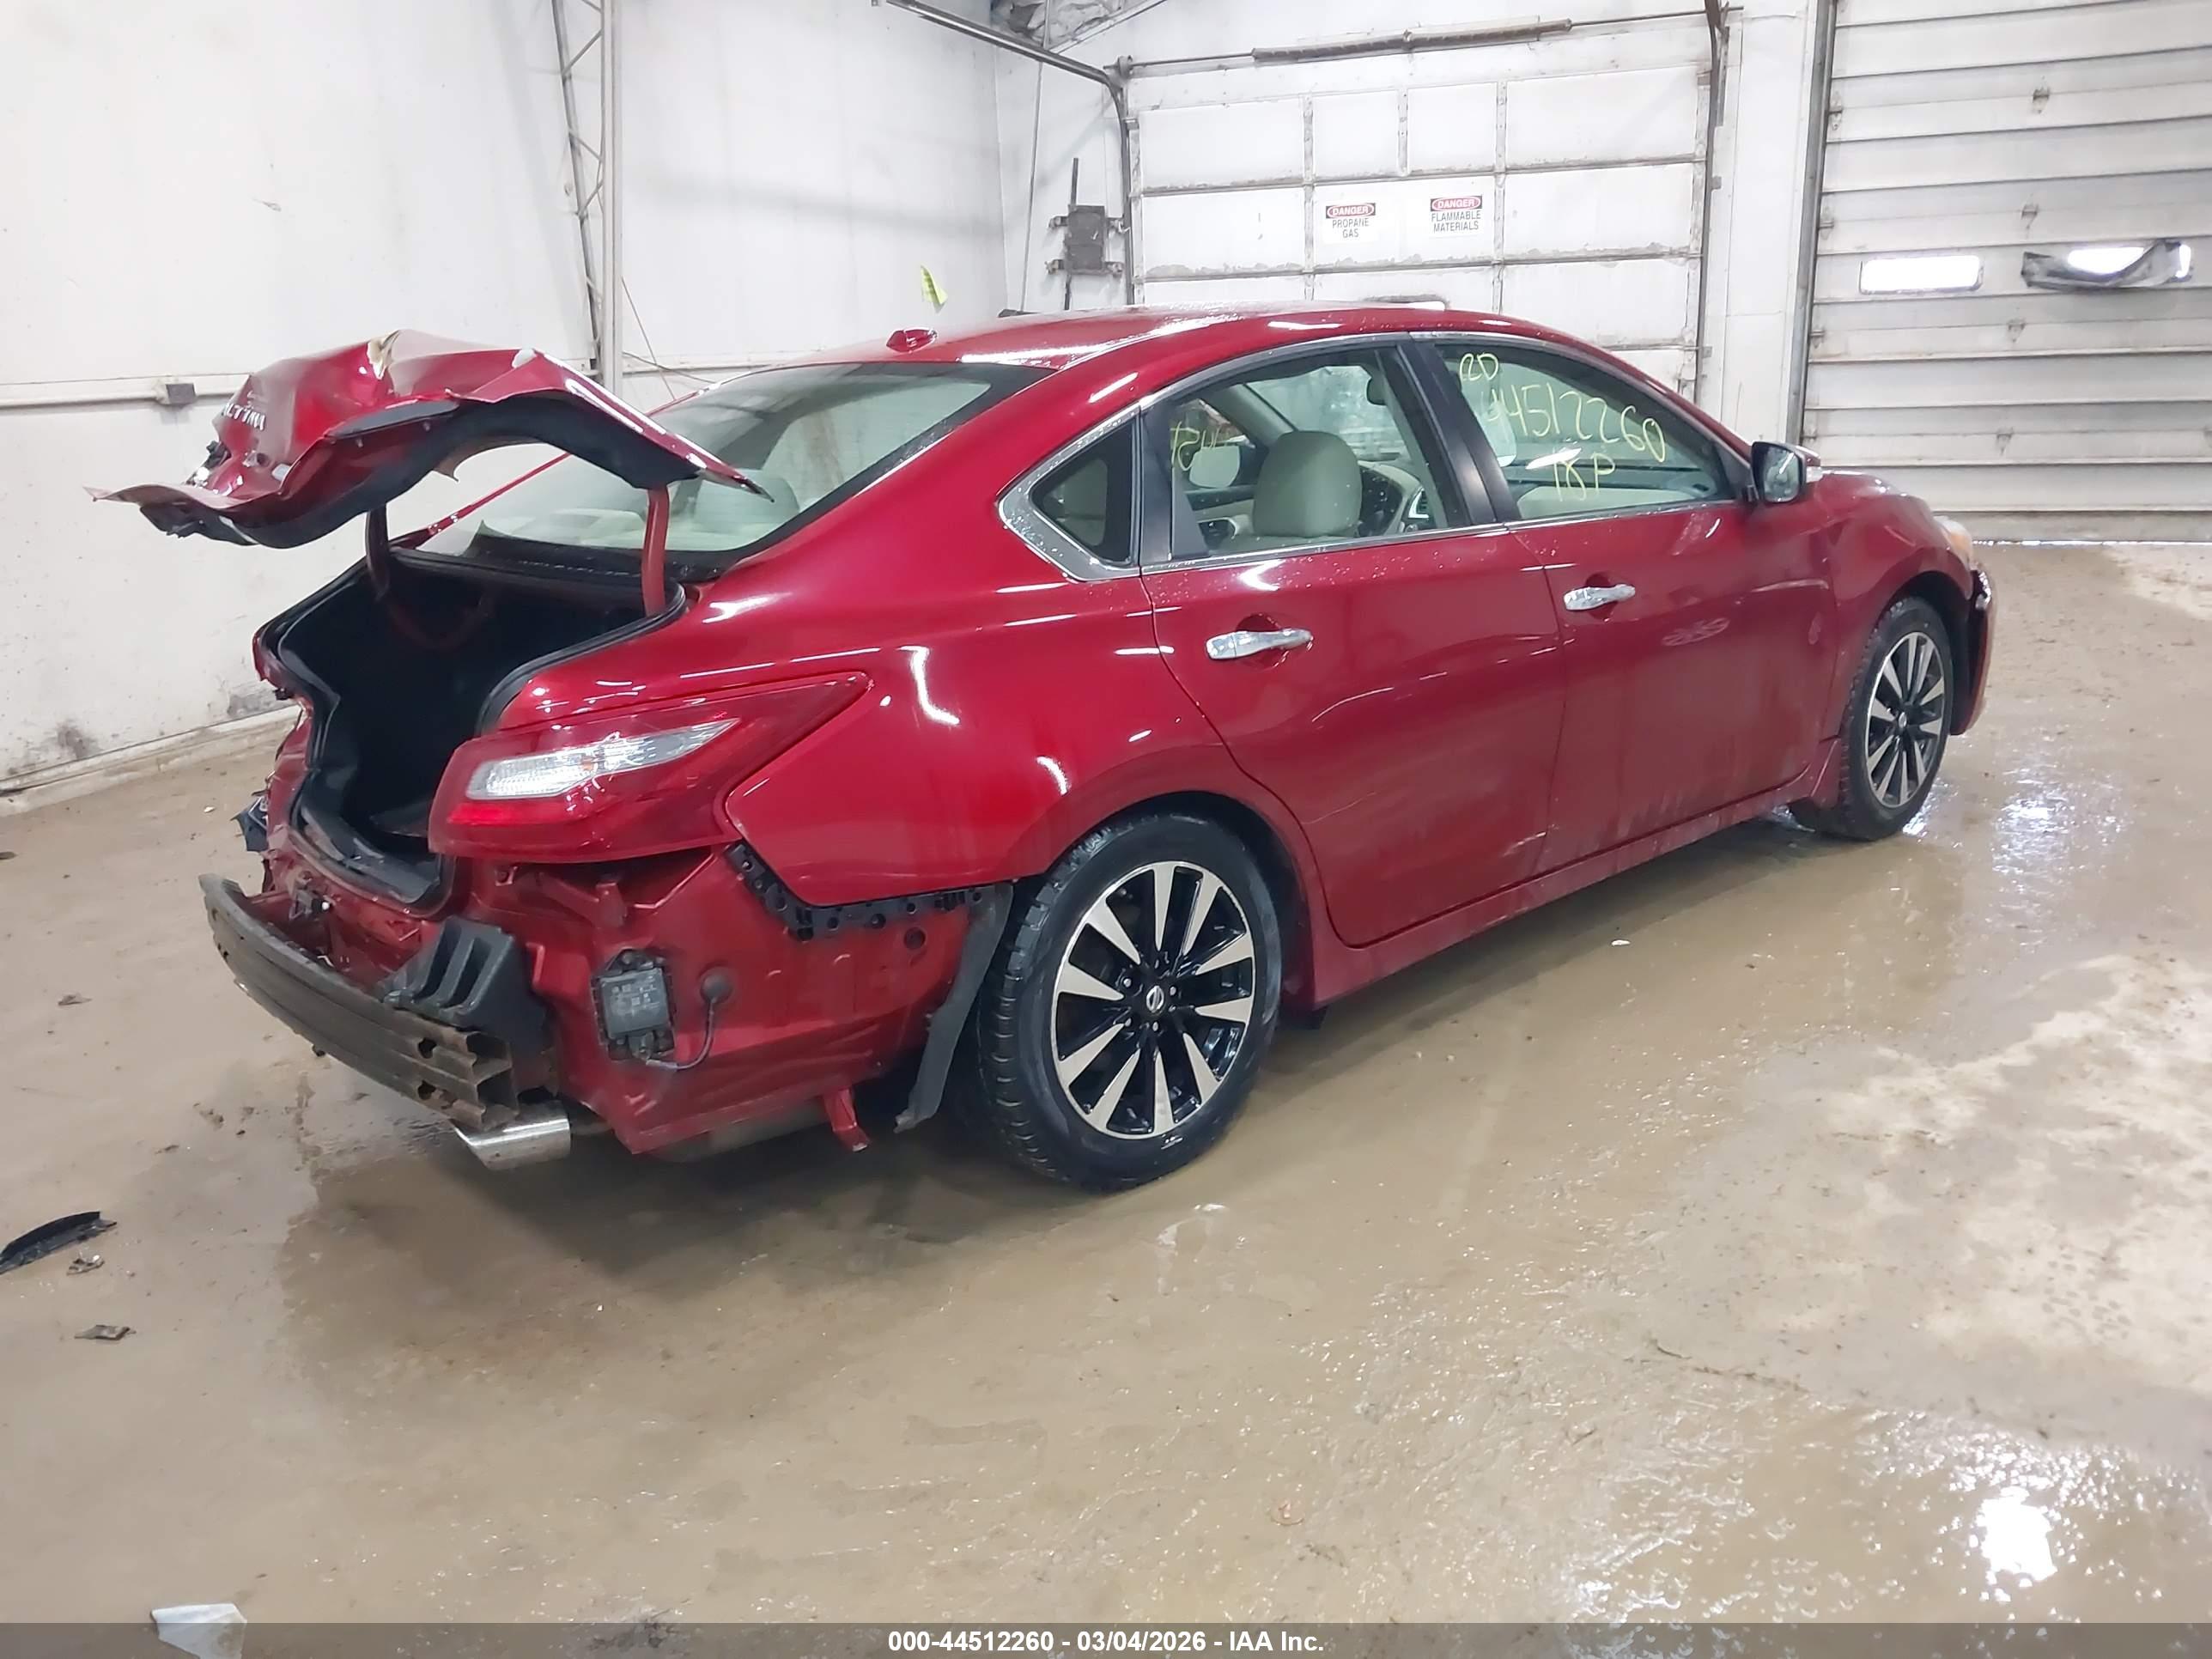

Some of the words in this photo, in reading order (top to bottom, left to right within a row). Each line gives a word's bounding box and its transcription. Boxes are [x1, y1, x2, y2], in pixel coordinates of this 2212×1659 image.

[1437, 198, 1475, 209] DANGER
[1333, 206, 1369, 216] DANGER
[1431, 210, 1481, 222] FLAMMABLE
[1333, 218, 1369, 228] PROPANE
[1434, 221, 1479, 233] MATERIALS
[1342, 228, 1359, 239] GAS
